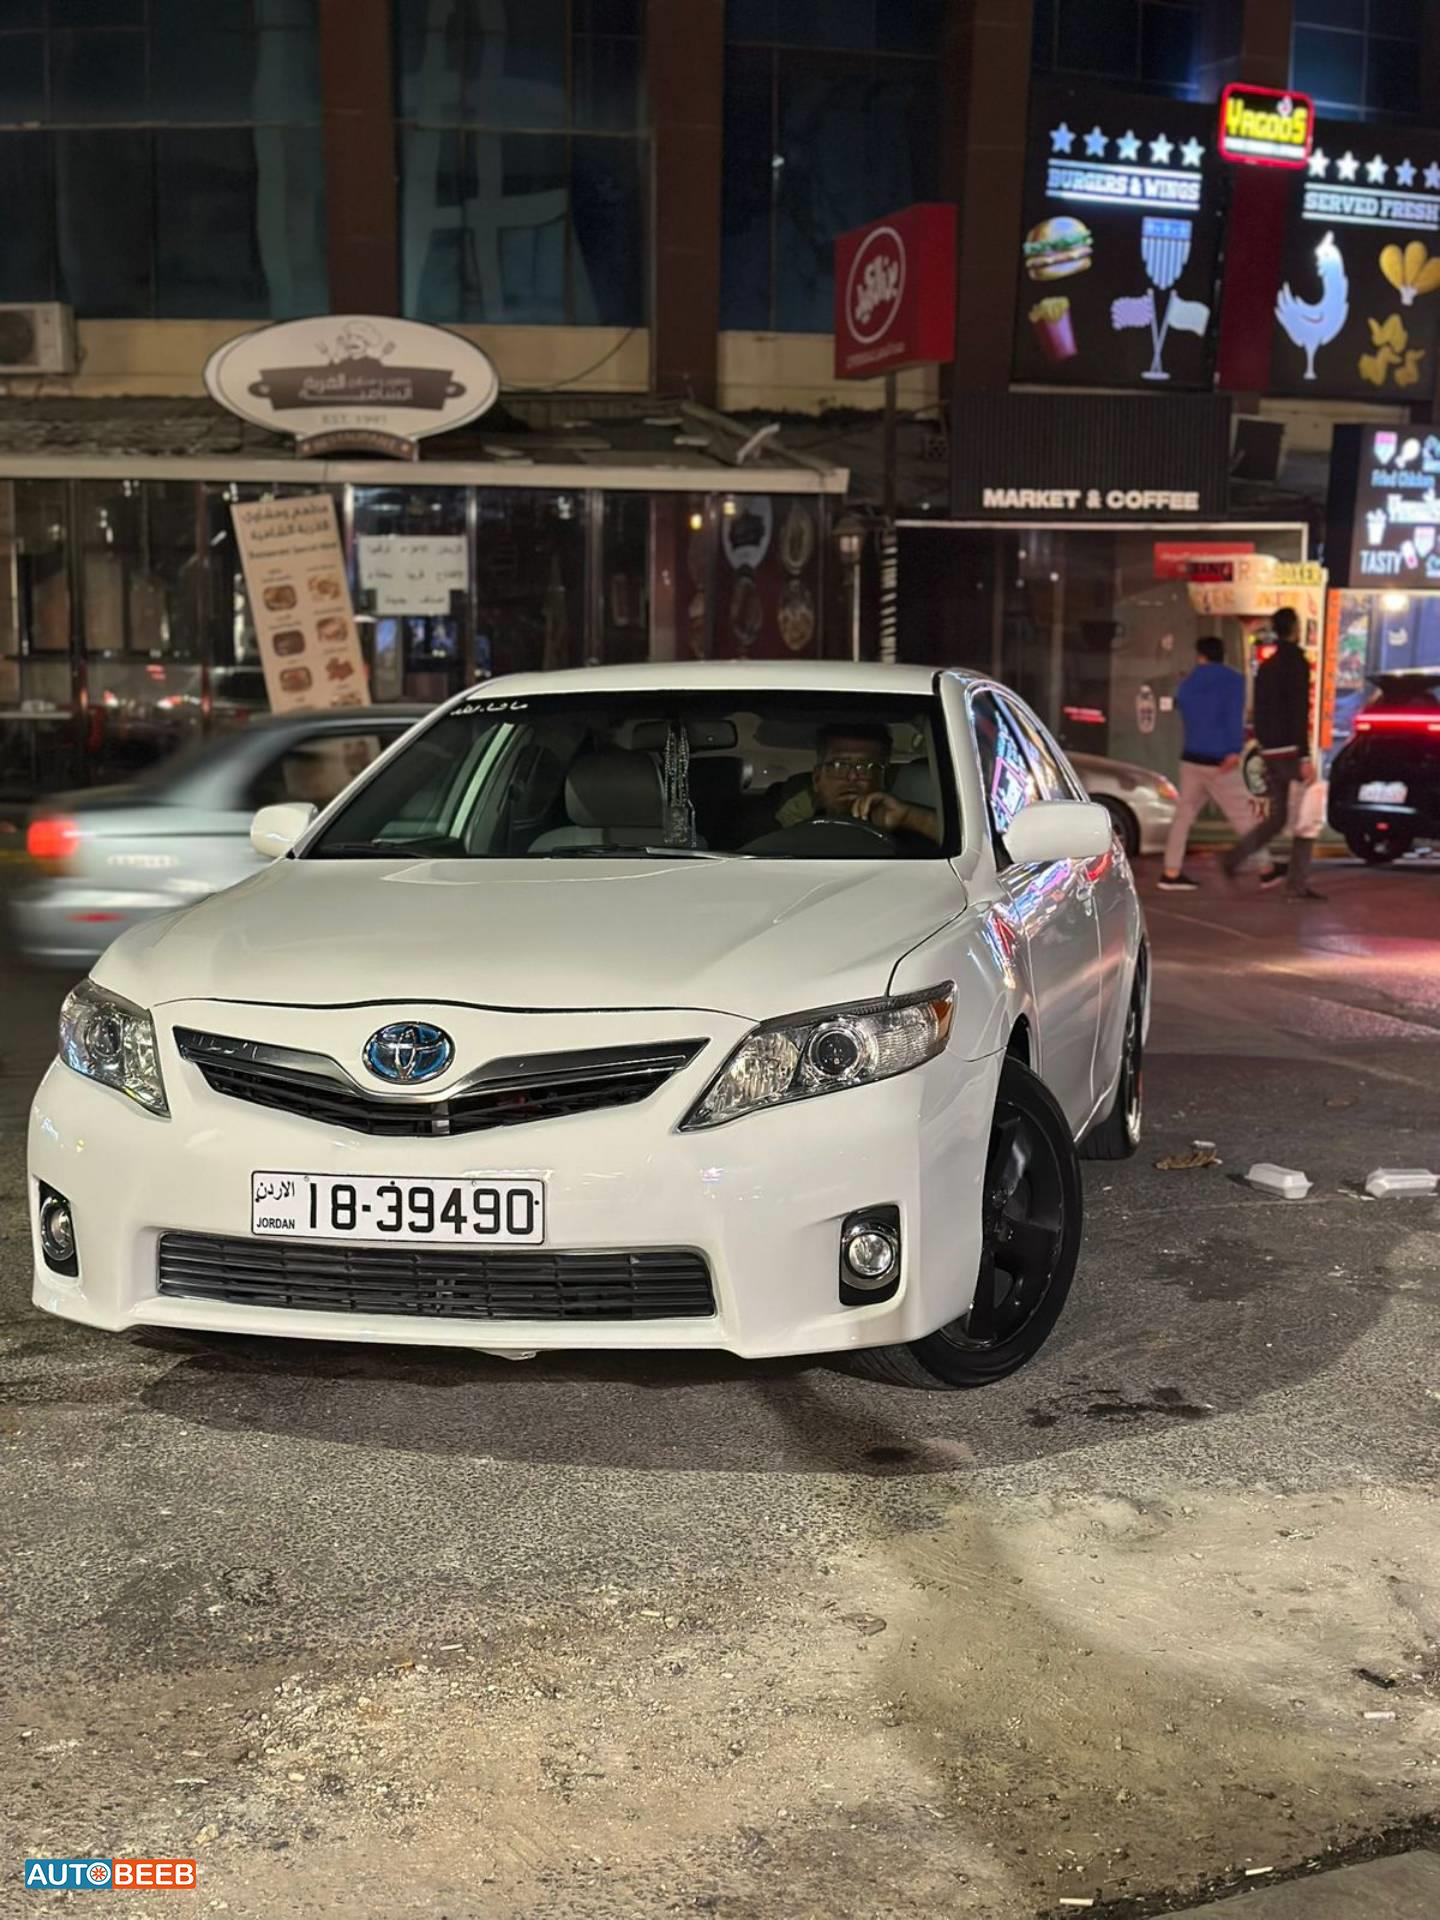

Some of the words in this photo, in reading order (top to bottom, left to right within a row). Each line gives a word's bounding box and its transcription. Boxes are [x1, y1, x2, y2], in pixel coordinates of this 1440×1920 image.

[1047, 167, 1128, 195] BURGERS
[1144, 177, 1200, 201] WINGS
[1303, 190, 1377, 217] SERVED
[1378, 197, 1439, 222] FRESH
[983, 489, 1081, 509] MARKET
[1086, 489, 1101, 509] &
[1106, 490, 1199, 511] COFFEE
[1360, 551, 1402, 575] TASTY
[309, 1182, 535, 1236] 18-39490
[256, 1217, 295, 1230] JORDAN
